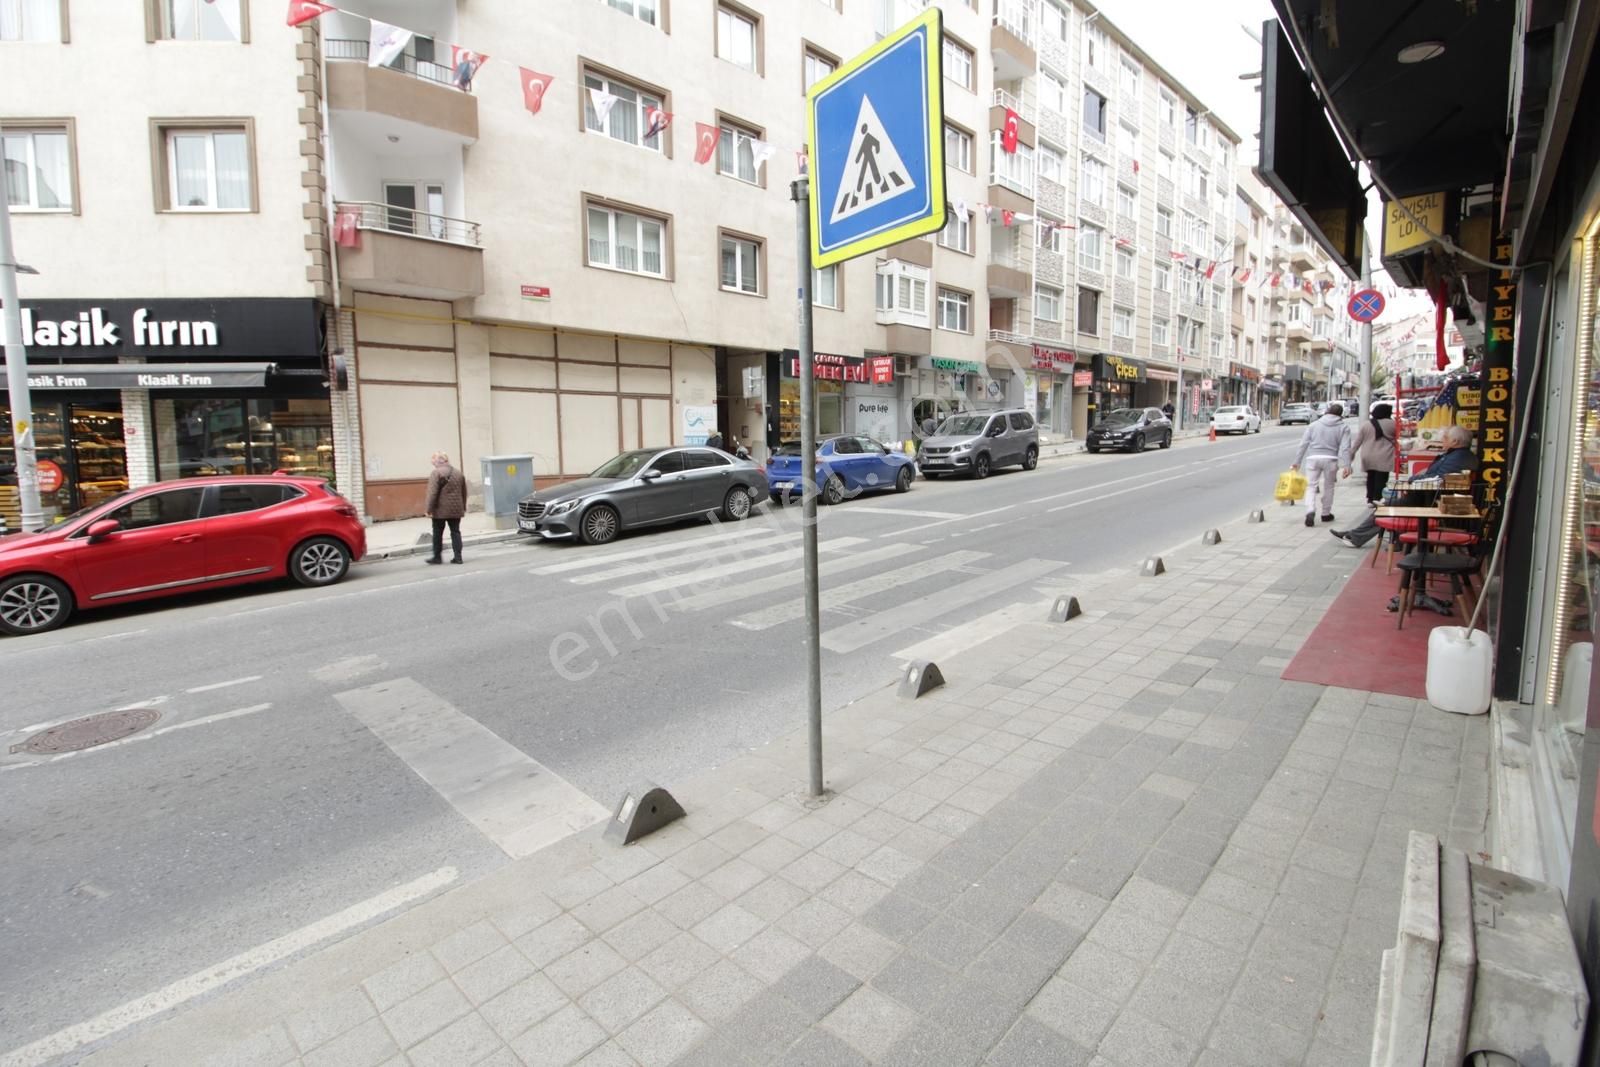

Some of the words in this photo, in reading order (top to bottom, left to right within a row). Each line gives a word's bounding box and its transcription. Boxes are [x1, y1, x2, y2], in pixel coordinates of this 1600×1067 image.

[1391, 194, 1439, 224] SAYISAL
[1399, 215, 1428, 238] LOTO
[0, 307, 121, 346] lasik
[132, 307, 218, 346] fırın
[791, 358, 841, 379] EMEK
[27, 375, 55, 387] asik
[138, 374, 180, 386] Klasik
[182, 374, 212, 385] Fırın
[859, 403, 876, 413] Pure
[1483, 366, 1509, 502] BÖREKÇİ
